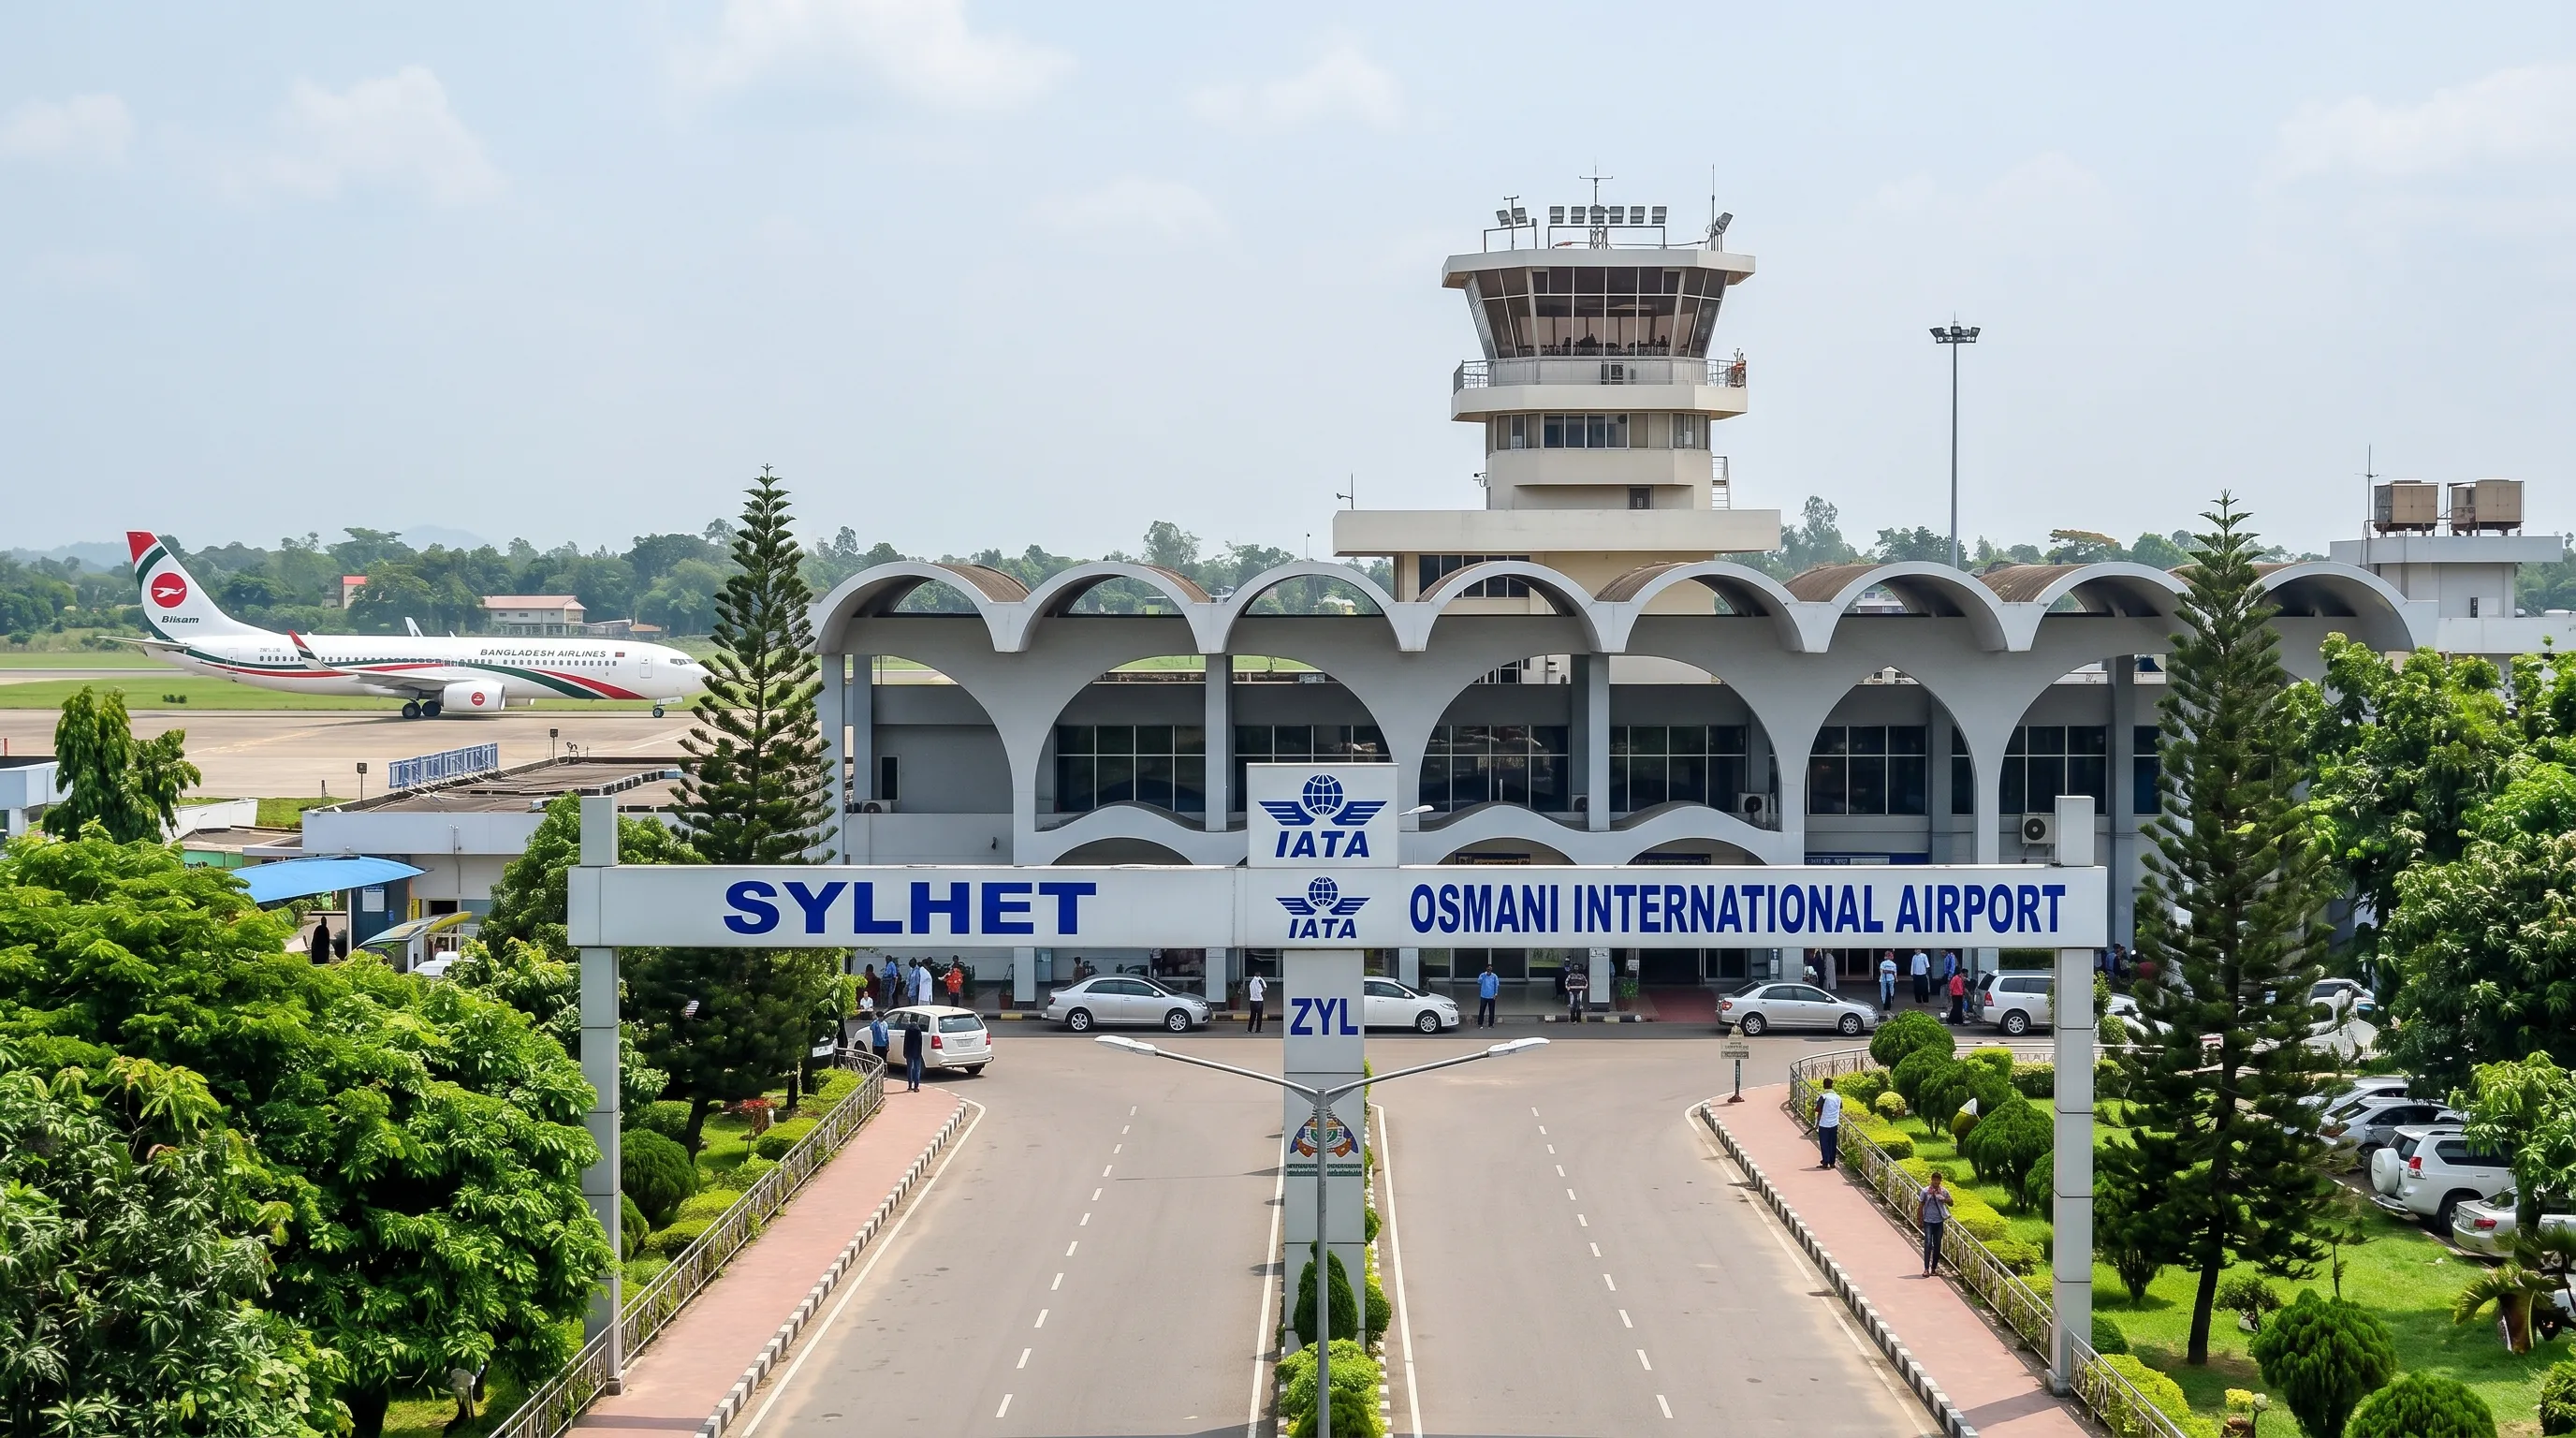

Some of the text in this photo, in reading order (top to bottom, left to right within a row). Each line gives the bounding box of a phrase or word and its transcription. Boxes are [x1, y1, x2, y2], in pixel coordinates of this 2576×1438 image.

[480, 649, 607, 658] BANGLADESH AIRLINES
[1275, 830, 1370, 858] IATA
[724, 880, 1097, 935] SYLHET
[1410, 883, 2066, 934] OSMANI INTERNATIONAL AIRPORT
[1288, 917, 1357, 939] IATA
[1290, 997, 1359, 1036] ZYL
